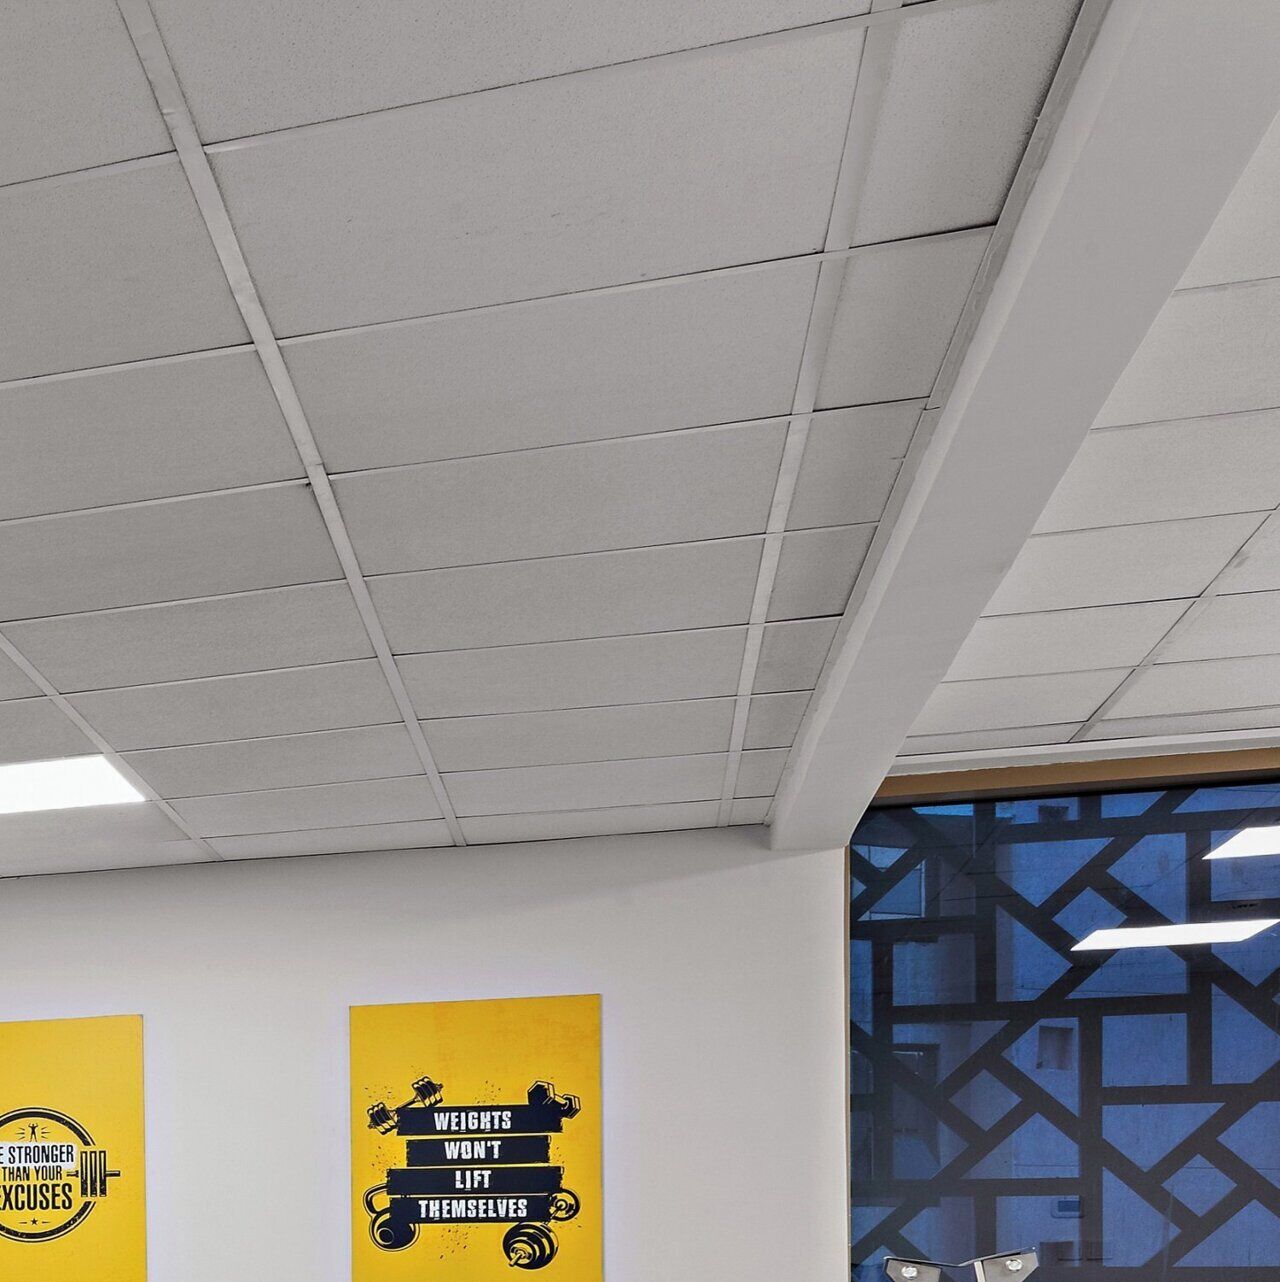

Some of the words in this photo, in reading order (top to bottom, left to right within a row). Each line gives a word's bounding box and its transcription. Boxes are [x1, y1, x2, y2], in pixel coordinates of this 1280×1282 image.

[433, 1111, 512, 1131] WEIGHTS
[8, 1144, 74, 1164] STRONGER
[444, 1140, 501, 1160] WON'T
[2, 1166, 30, 1182] THAN
[34, 1165, 62, 1181] YOUR
[455, 1170, 492, 1191] LIFT
[418, 1198, 528, 1220] THEMSELVES
